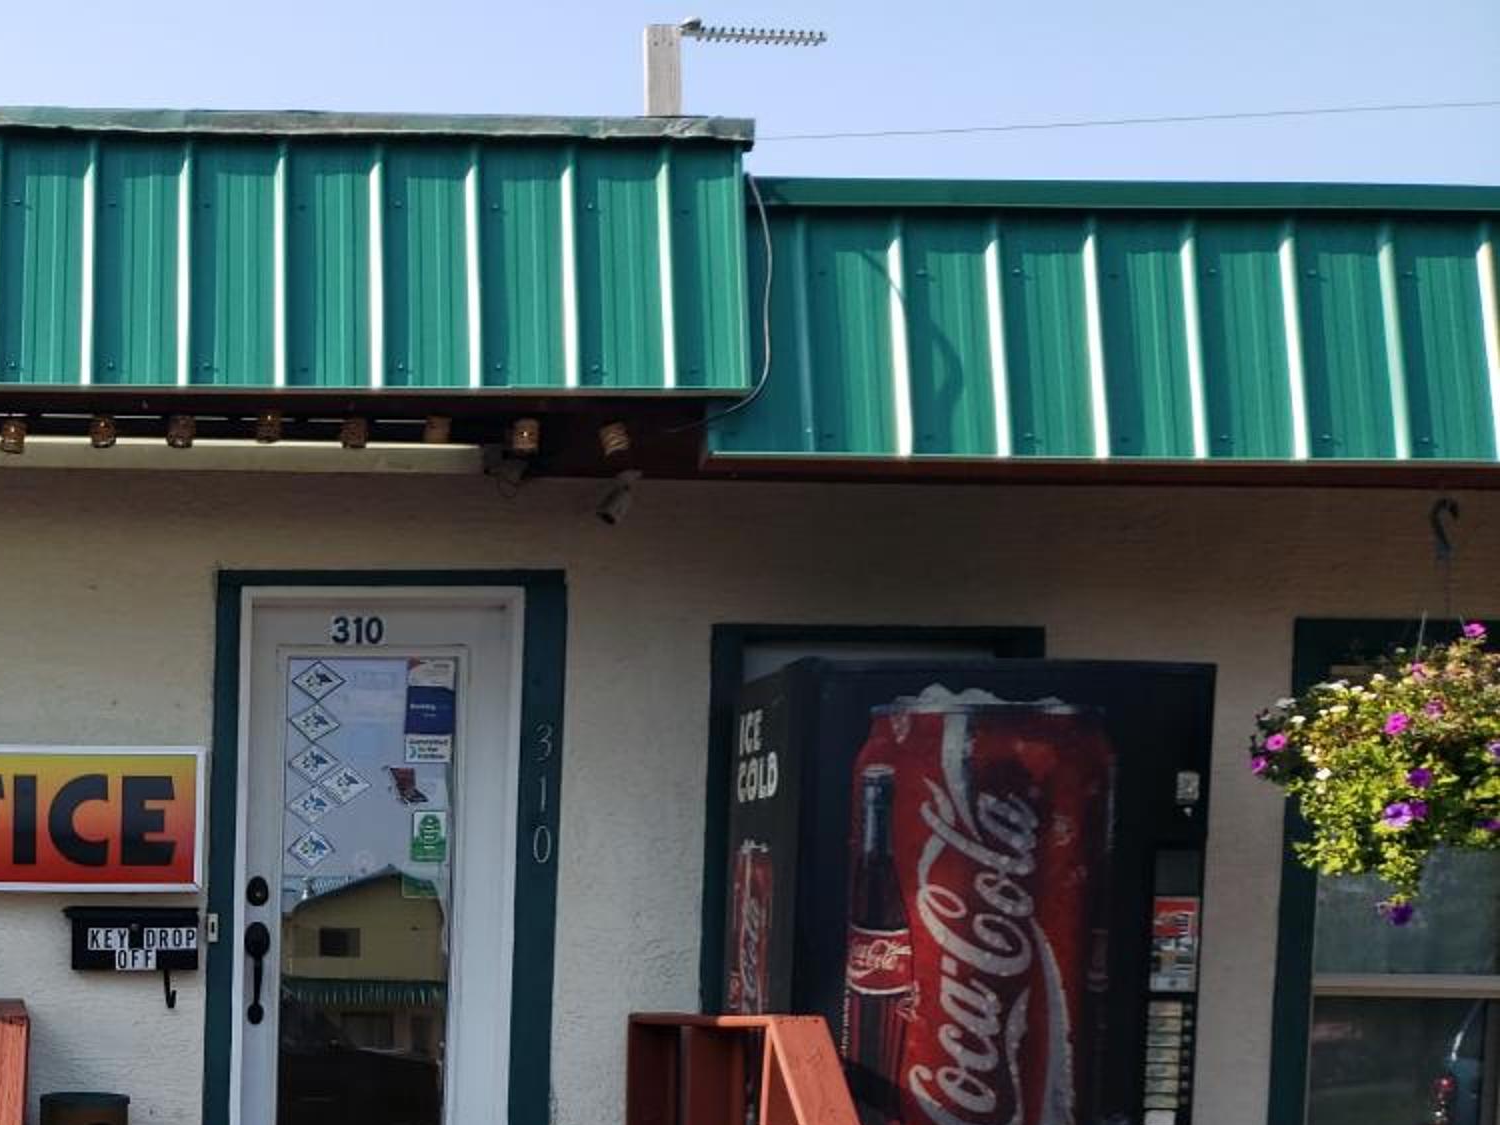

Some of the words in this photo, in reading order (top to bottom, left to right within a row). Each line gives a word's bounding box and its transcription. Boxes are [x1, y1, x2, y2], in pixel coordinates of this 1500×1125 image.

[331, 617, 385, 645] 310
[739, 708, 763, 755] ICE
[532, 724, 554, 863] 310
[737, 751, 779, 803] COLD
[89, 929, 128, 949] KEY
[145, 929, 196, 949] DROP
[117, 949, 154, 969] OFF
